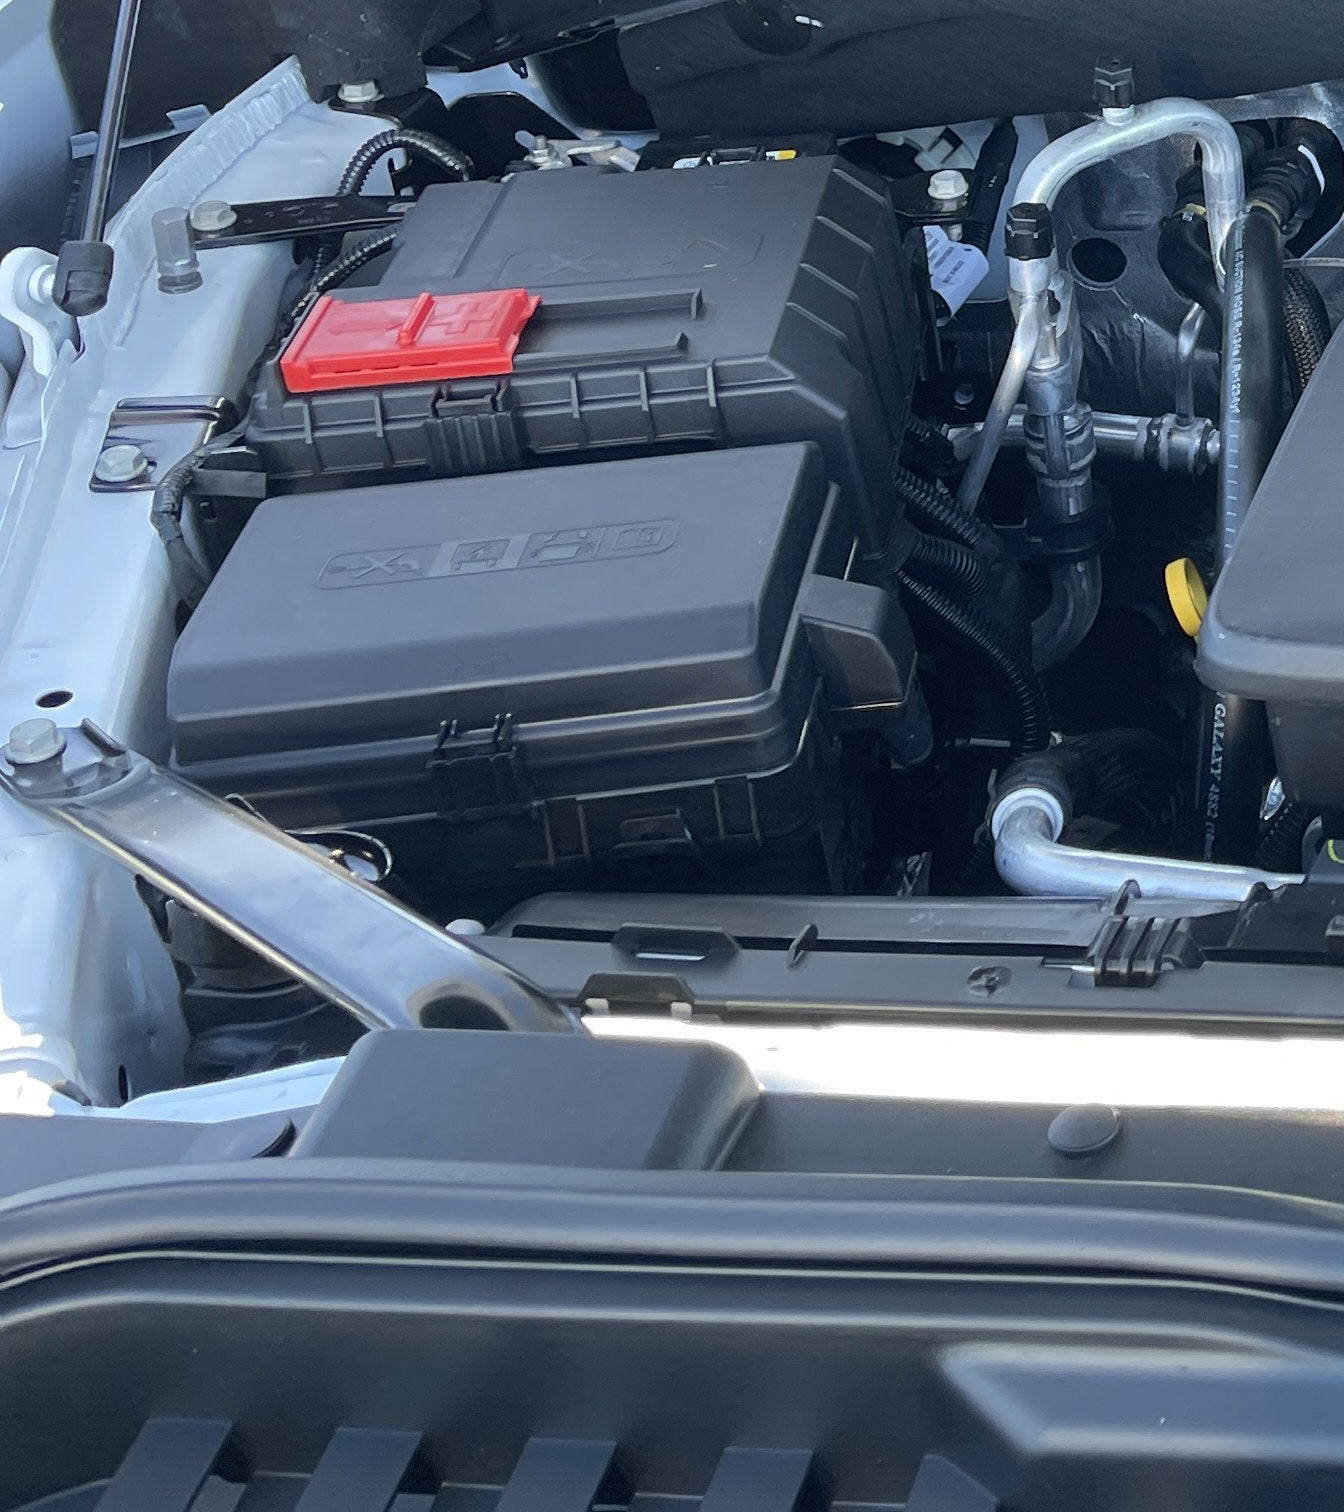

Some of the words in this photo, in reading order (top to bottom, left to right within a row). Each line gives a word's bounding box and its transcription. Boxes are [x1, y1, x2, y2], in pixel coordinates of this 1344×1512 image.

[1233, 292, 1242, 320] HOSE
[1230, 363, 1241, 413] R-1234yf
[1211, 703, 1227, 782] GALAXY
